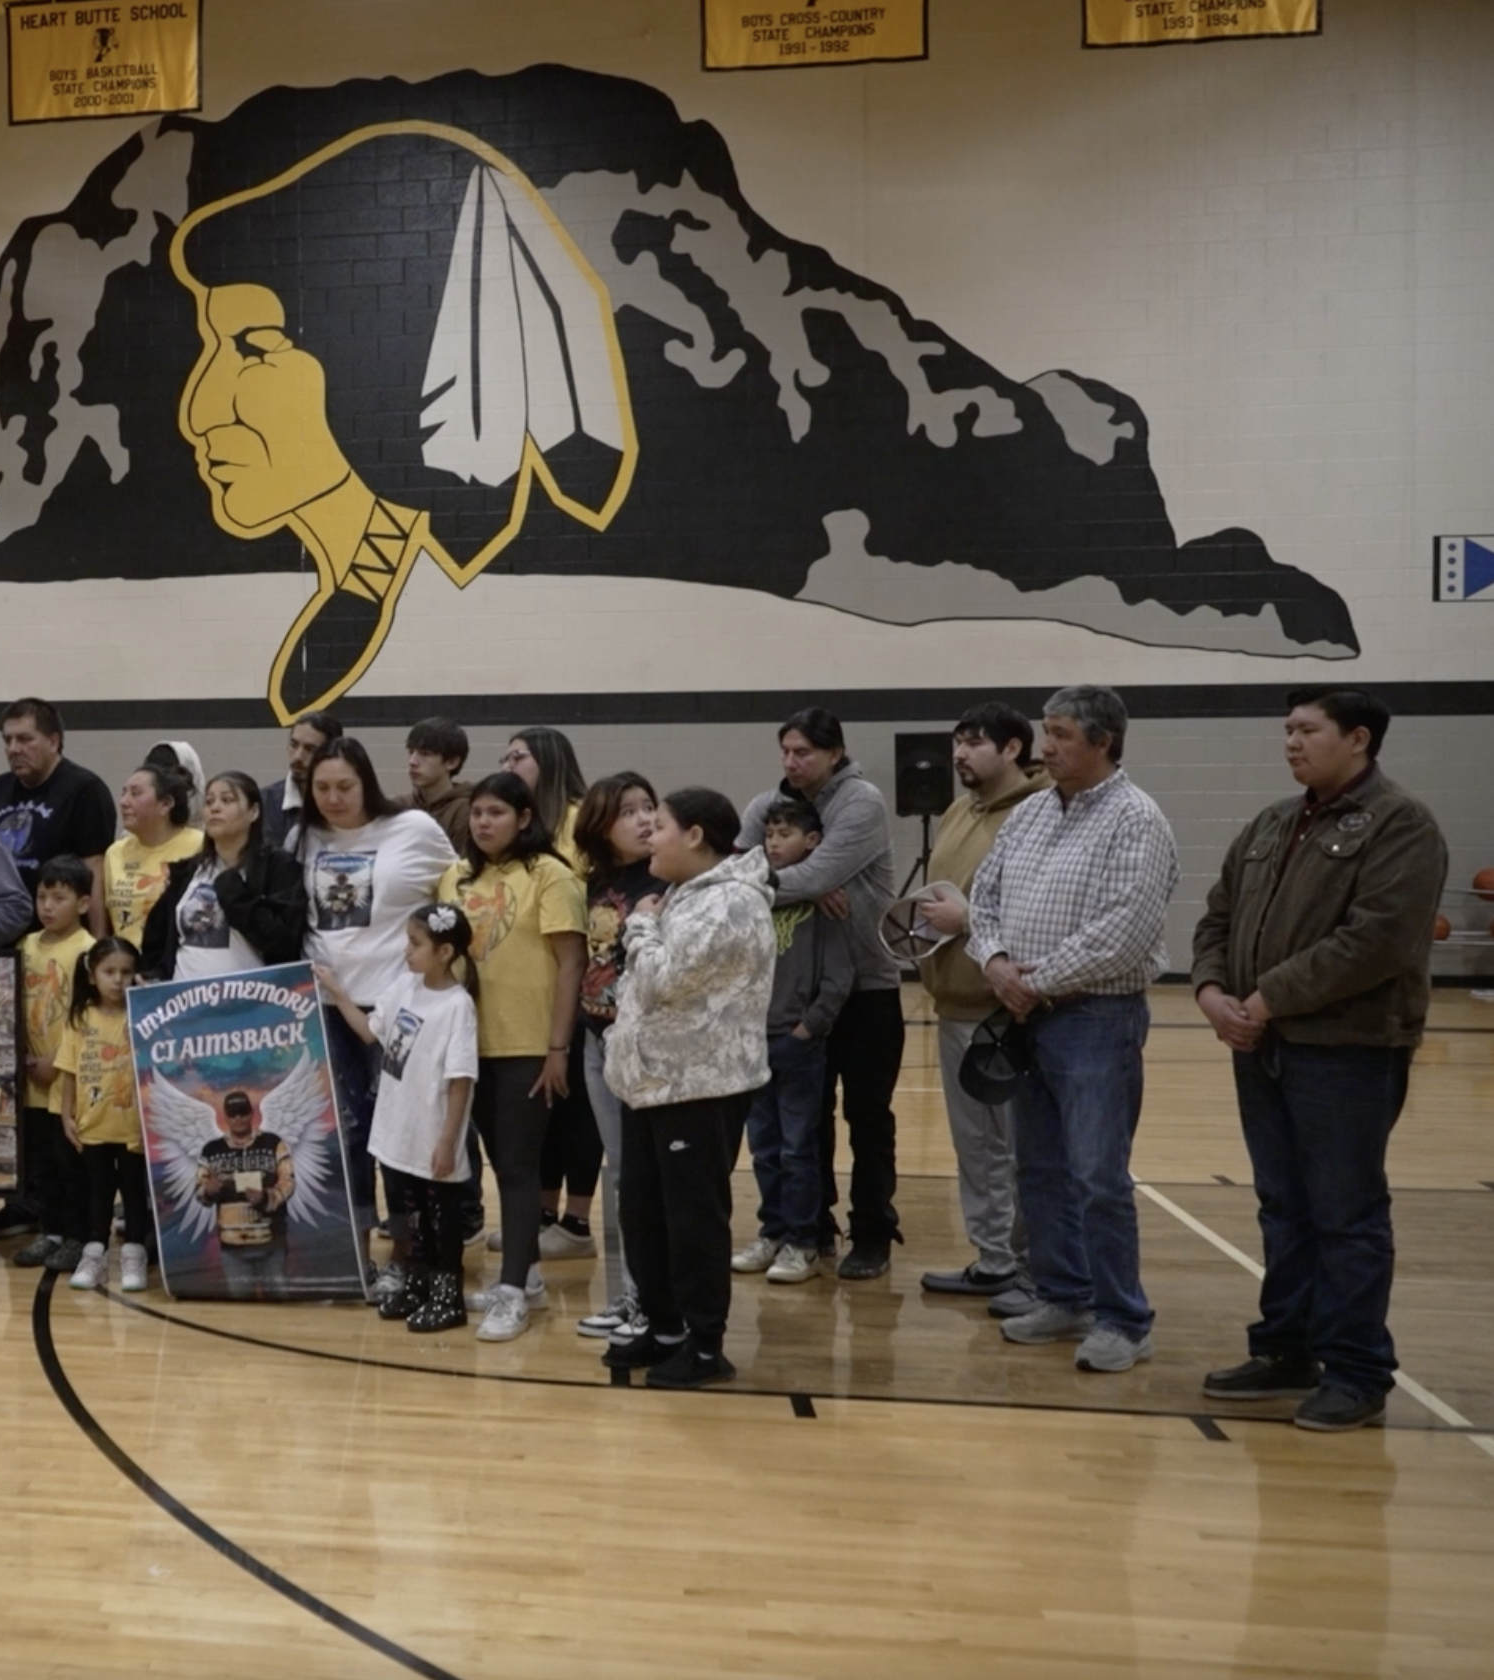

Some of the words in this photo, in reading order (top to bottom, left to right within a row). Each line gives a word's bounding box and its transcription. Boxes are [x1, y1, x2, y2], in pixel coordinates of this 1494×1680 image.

[20, 12, 66, 30] HEART
[75, 8, 121, 26] BUTTE
[130, 3, 187, 21] SCHOOL
[741, 14, 773, 28] BOYS
[780, 7, 886, 26] CROSS-COUNTRY
[1135, 1, 1174, 18] STATE
[1189, 0, 1266, 13] CHAMPIONS
[753, 28, 789, 42] STATE
[805, 22, 875, 39] CHAMPIONS
[49, 69, 77, 82] BOYS
[86, 64, 158, 79] BASKETBALL
[53, 82, 85, 96] STATE
[93, 78, 156, 92] CHAMPIONS
[74, 93, 134, 108] 2000-2001
[157, 982, 220, 1023] LOVING
[222, 980, 317, 1020] MEMORY
[150, 1038, 177, 1064] CJ
[180, 1022, 306, 1059] AIMSBACK
